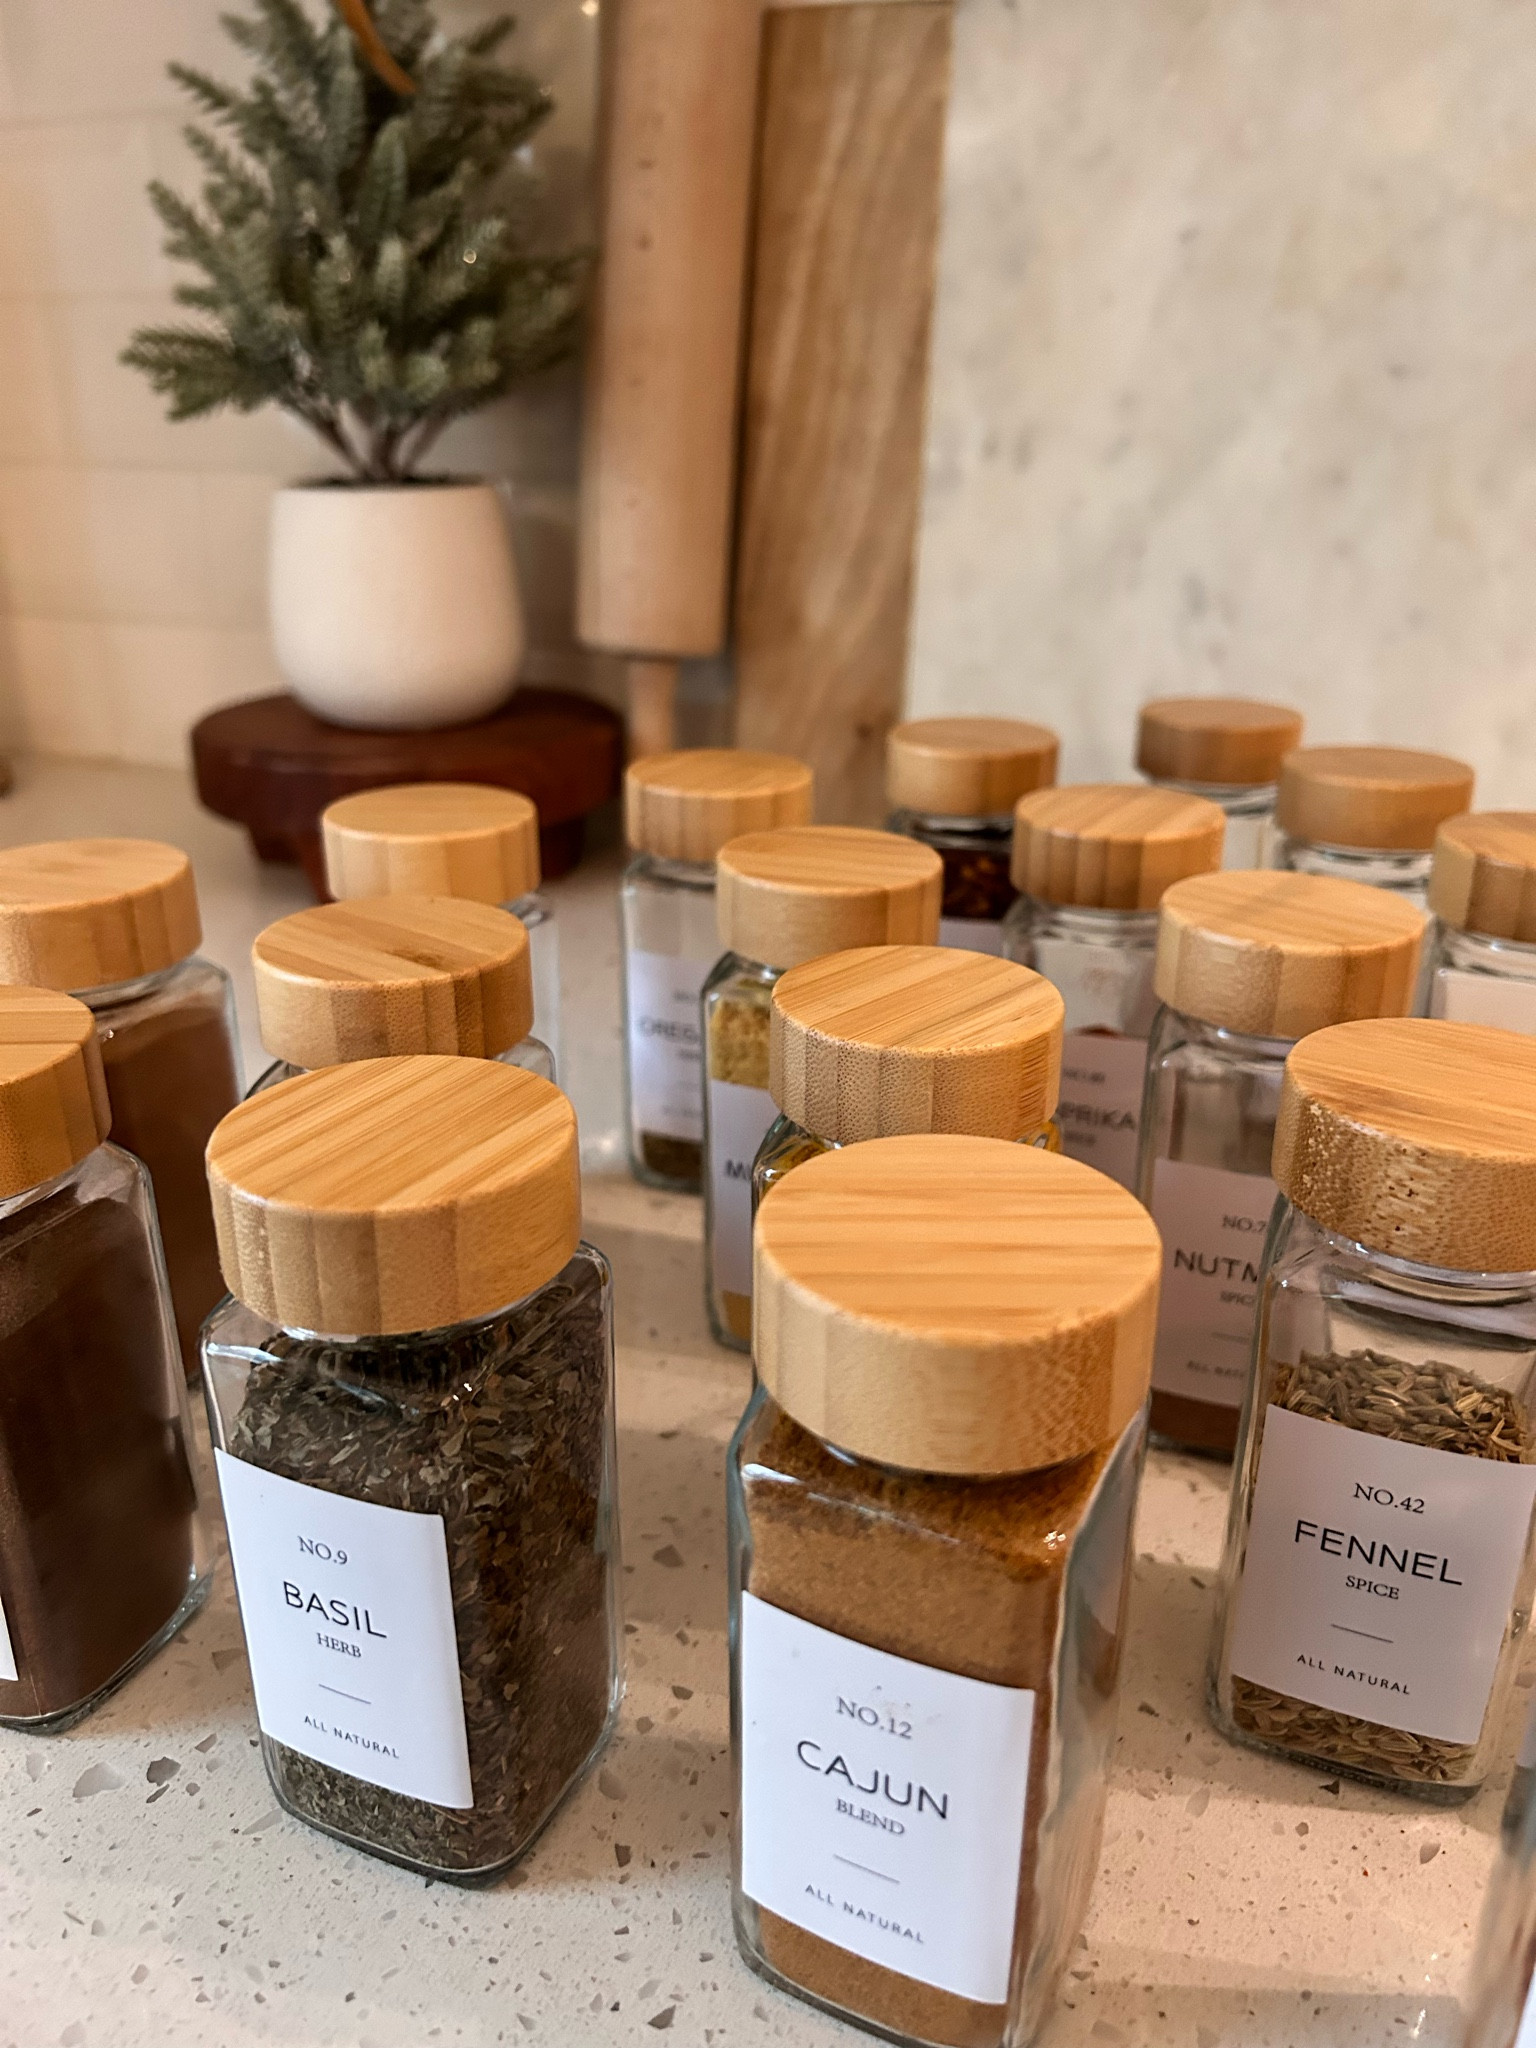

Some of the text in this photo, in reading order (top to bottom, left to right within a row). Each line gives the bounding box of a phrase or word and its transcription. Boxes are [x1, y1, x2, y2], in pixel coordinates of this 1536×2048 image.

[1353, 1482, 1426, 1514] NO.42
[297, 1535, 348, 1565] NO.9
[1294, 1519, 1463, 1586] FENNEL
[1345, 1575, 1400, 1600] SPICE
[283, 1581, 387, 1639] BASIL
[316, 1632, 362, 1659] HERB
[1297, 1653, 1411, 1696] ALL NATURAL
[303, 1714, 400, 1760] ALL NATURAL
[836, 1695, 913, 1740] NO.12
[797, 1739, 949, 1820] CAJUN
[836, 1797, 906, 1837] BLEND
[804, 1883, 925, 1945] ALL NATURAL
